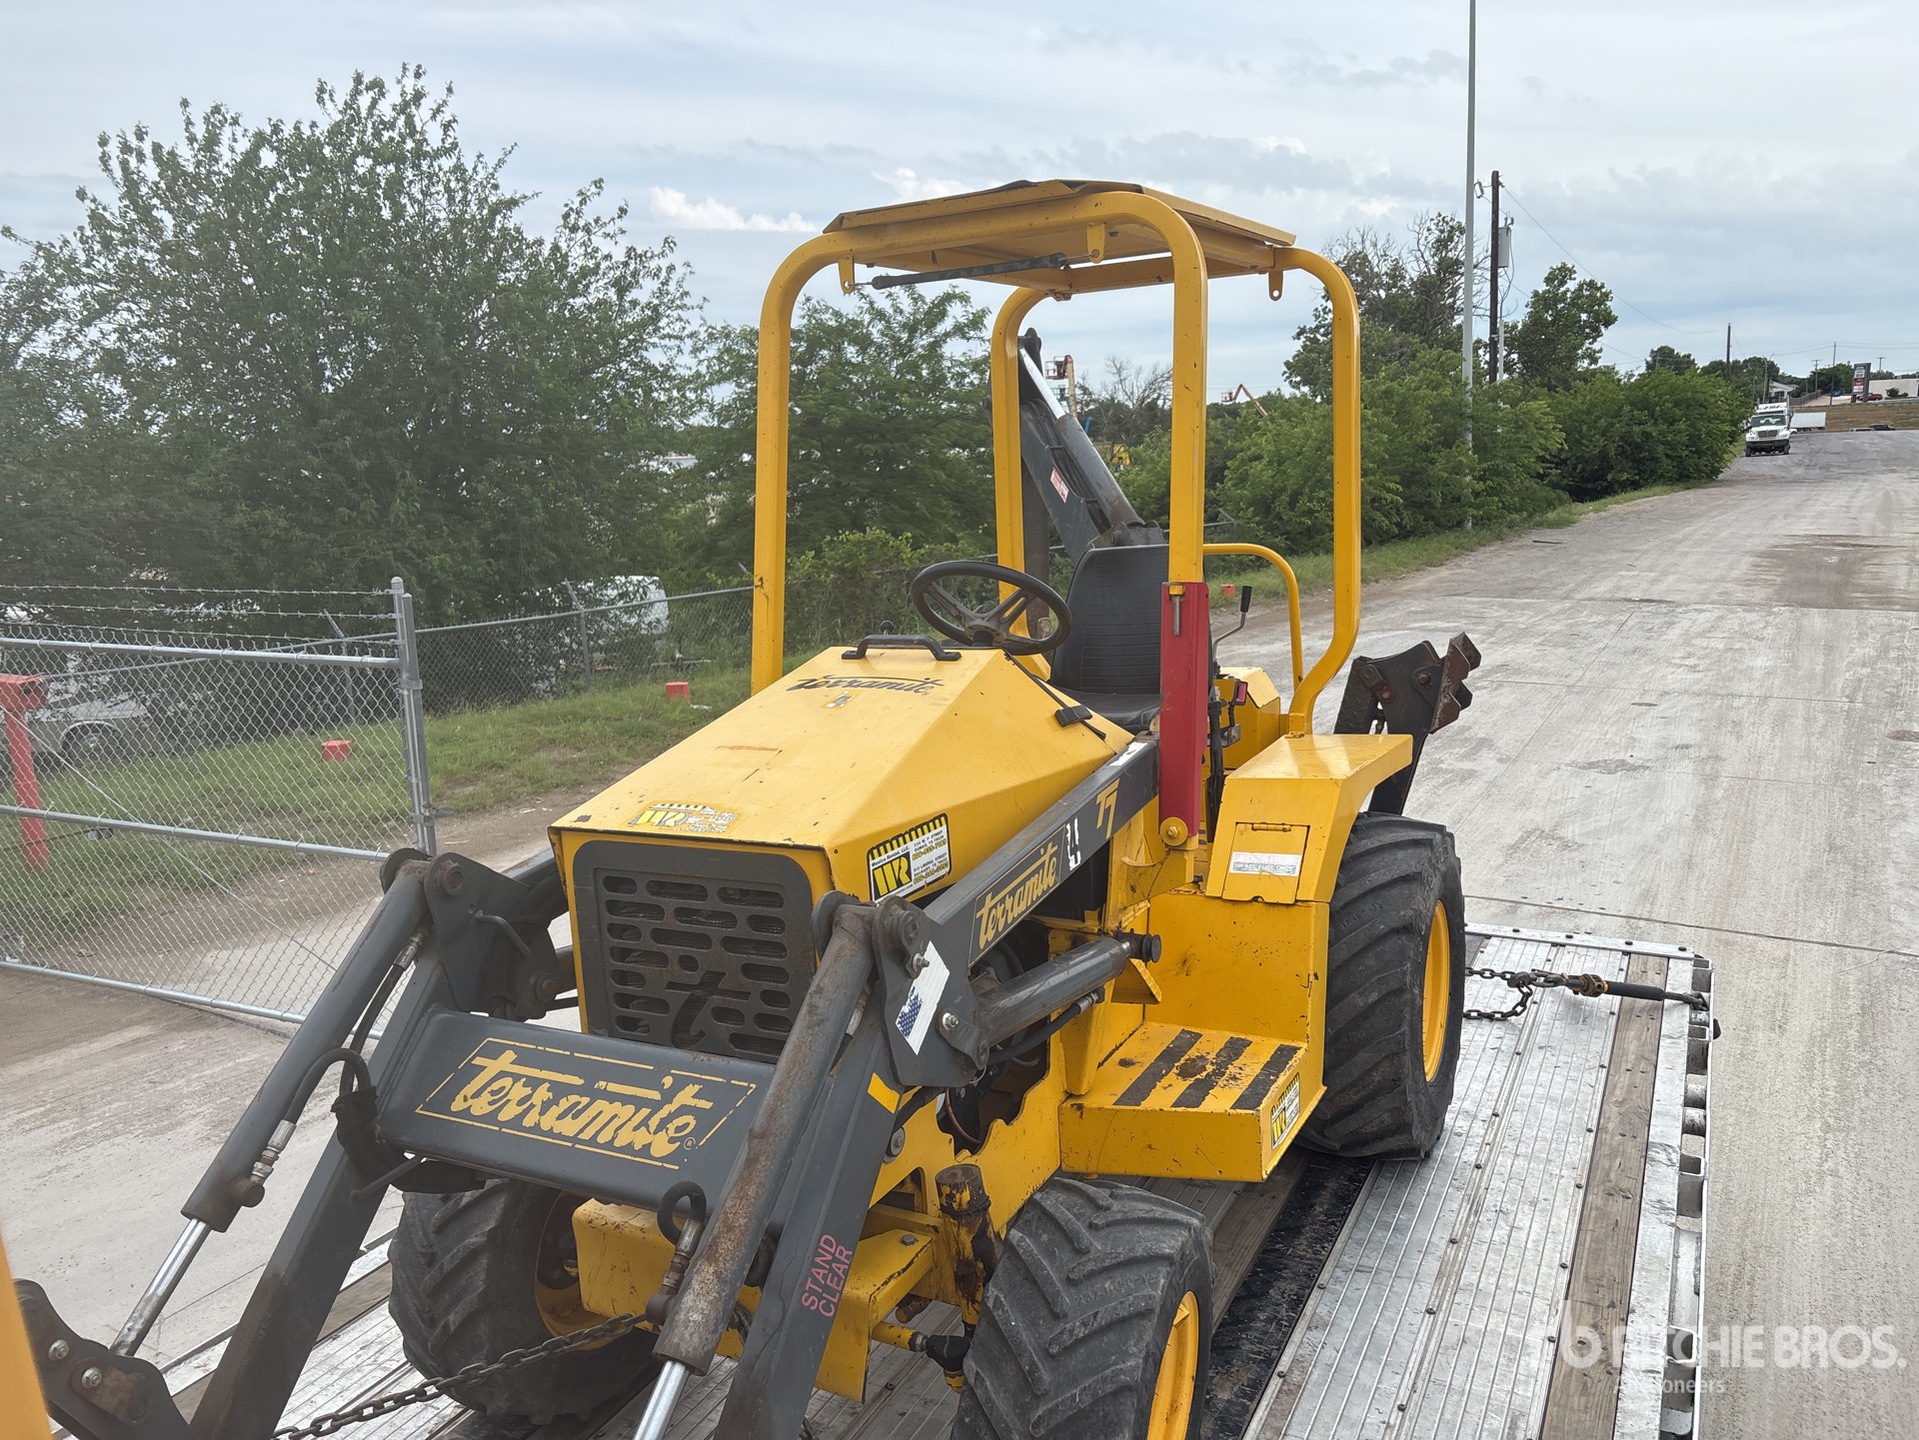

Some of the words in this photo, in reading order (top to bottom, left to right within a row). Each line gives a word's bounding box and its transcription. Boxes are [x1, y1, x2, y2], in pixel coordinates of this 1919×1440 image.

[976, 842, 1058, 950] terramite
[450, 1050, 714, 1158] terramite
[801, 1234, 837, 1311] STAND
[818, 1245, 853, 1317] CLEAR
